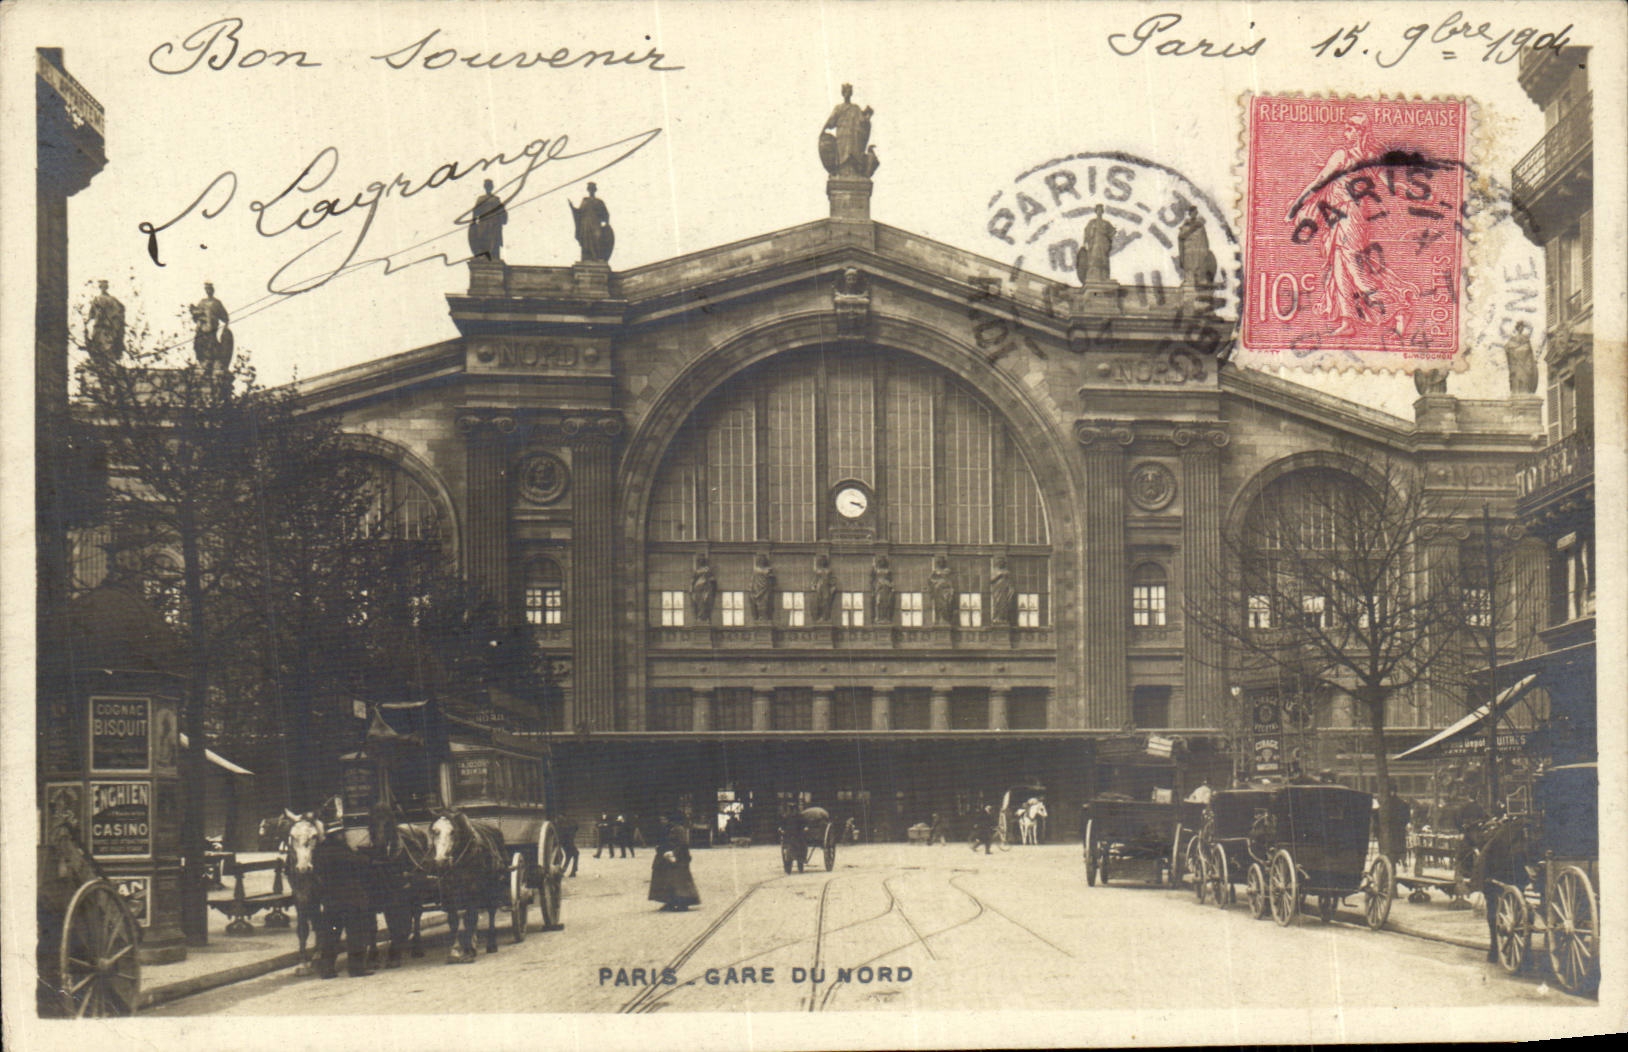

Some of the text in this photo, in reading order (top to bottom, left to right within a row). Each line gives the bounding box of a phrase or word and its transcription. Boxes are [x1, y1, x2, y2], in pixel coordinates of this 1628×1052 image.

[149, 17, 322, 75] Bon
[1108, 13, 1267, 58] Paris
[1373, 106, 1458, 128] FRANÇAISE
[1430, 253, 1452, 340] POSTES
[498, 342, 579, 368] NORD
[96, 703, 145, 716] COGNAC
[94, 718, 148, 738] BISQUIT
[92, 784, 149, 817] ENGHIEN
[93, 822, 149, 837] CASINO
